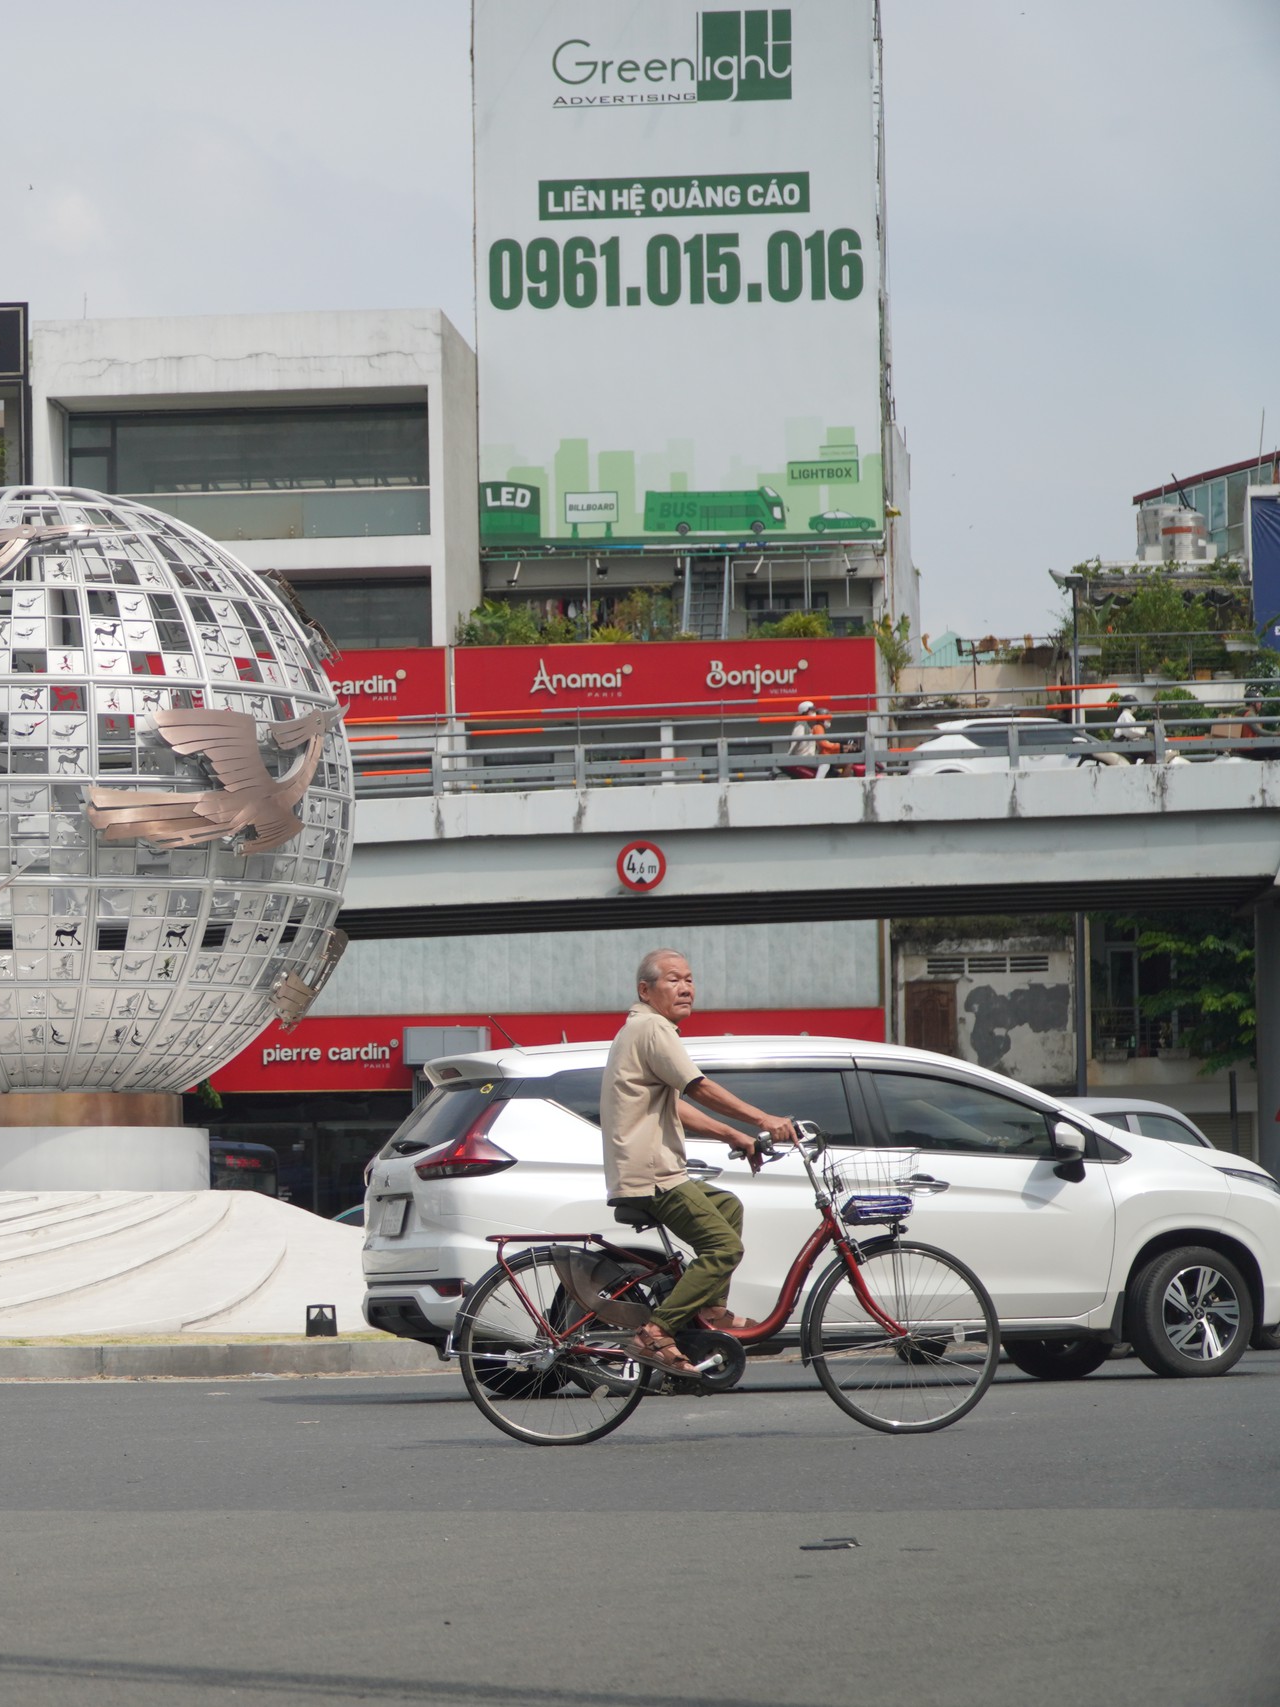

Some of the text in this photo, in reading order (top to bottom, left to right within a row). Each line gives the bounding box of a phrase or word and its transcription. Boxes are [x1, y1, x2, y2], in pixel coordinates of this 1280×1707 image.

[552, 9, 792, 101] Greenlight
[553, 92, 697, 105] ADVERTISING
[547, 178, 801, 216] LIÊN HỆ QUẢNG CÁO
[488, 228, 864, 311] 0961.015.016
[790, 467, 852, 481] LIGHTBOX
[486, 487, 532, 508] LED
[568, 502, 615, 512] BILLBOARD
[659, 502, 698, 518] BUS
[530, 659, 623, 695] Anamai
[706, 659, 799, 695] Bonjour
[262, 1043, 390, 1066] pierre cardin
